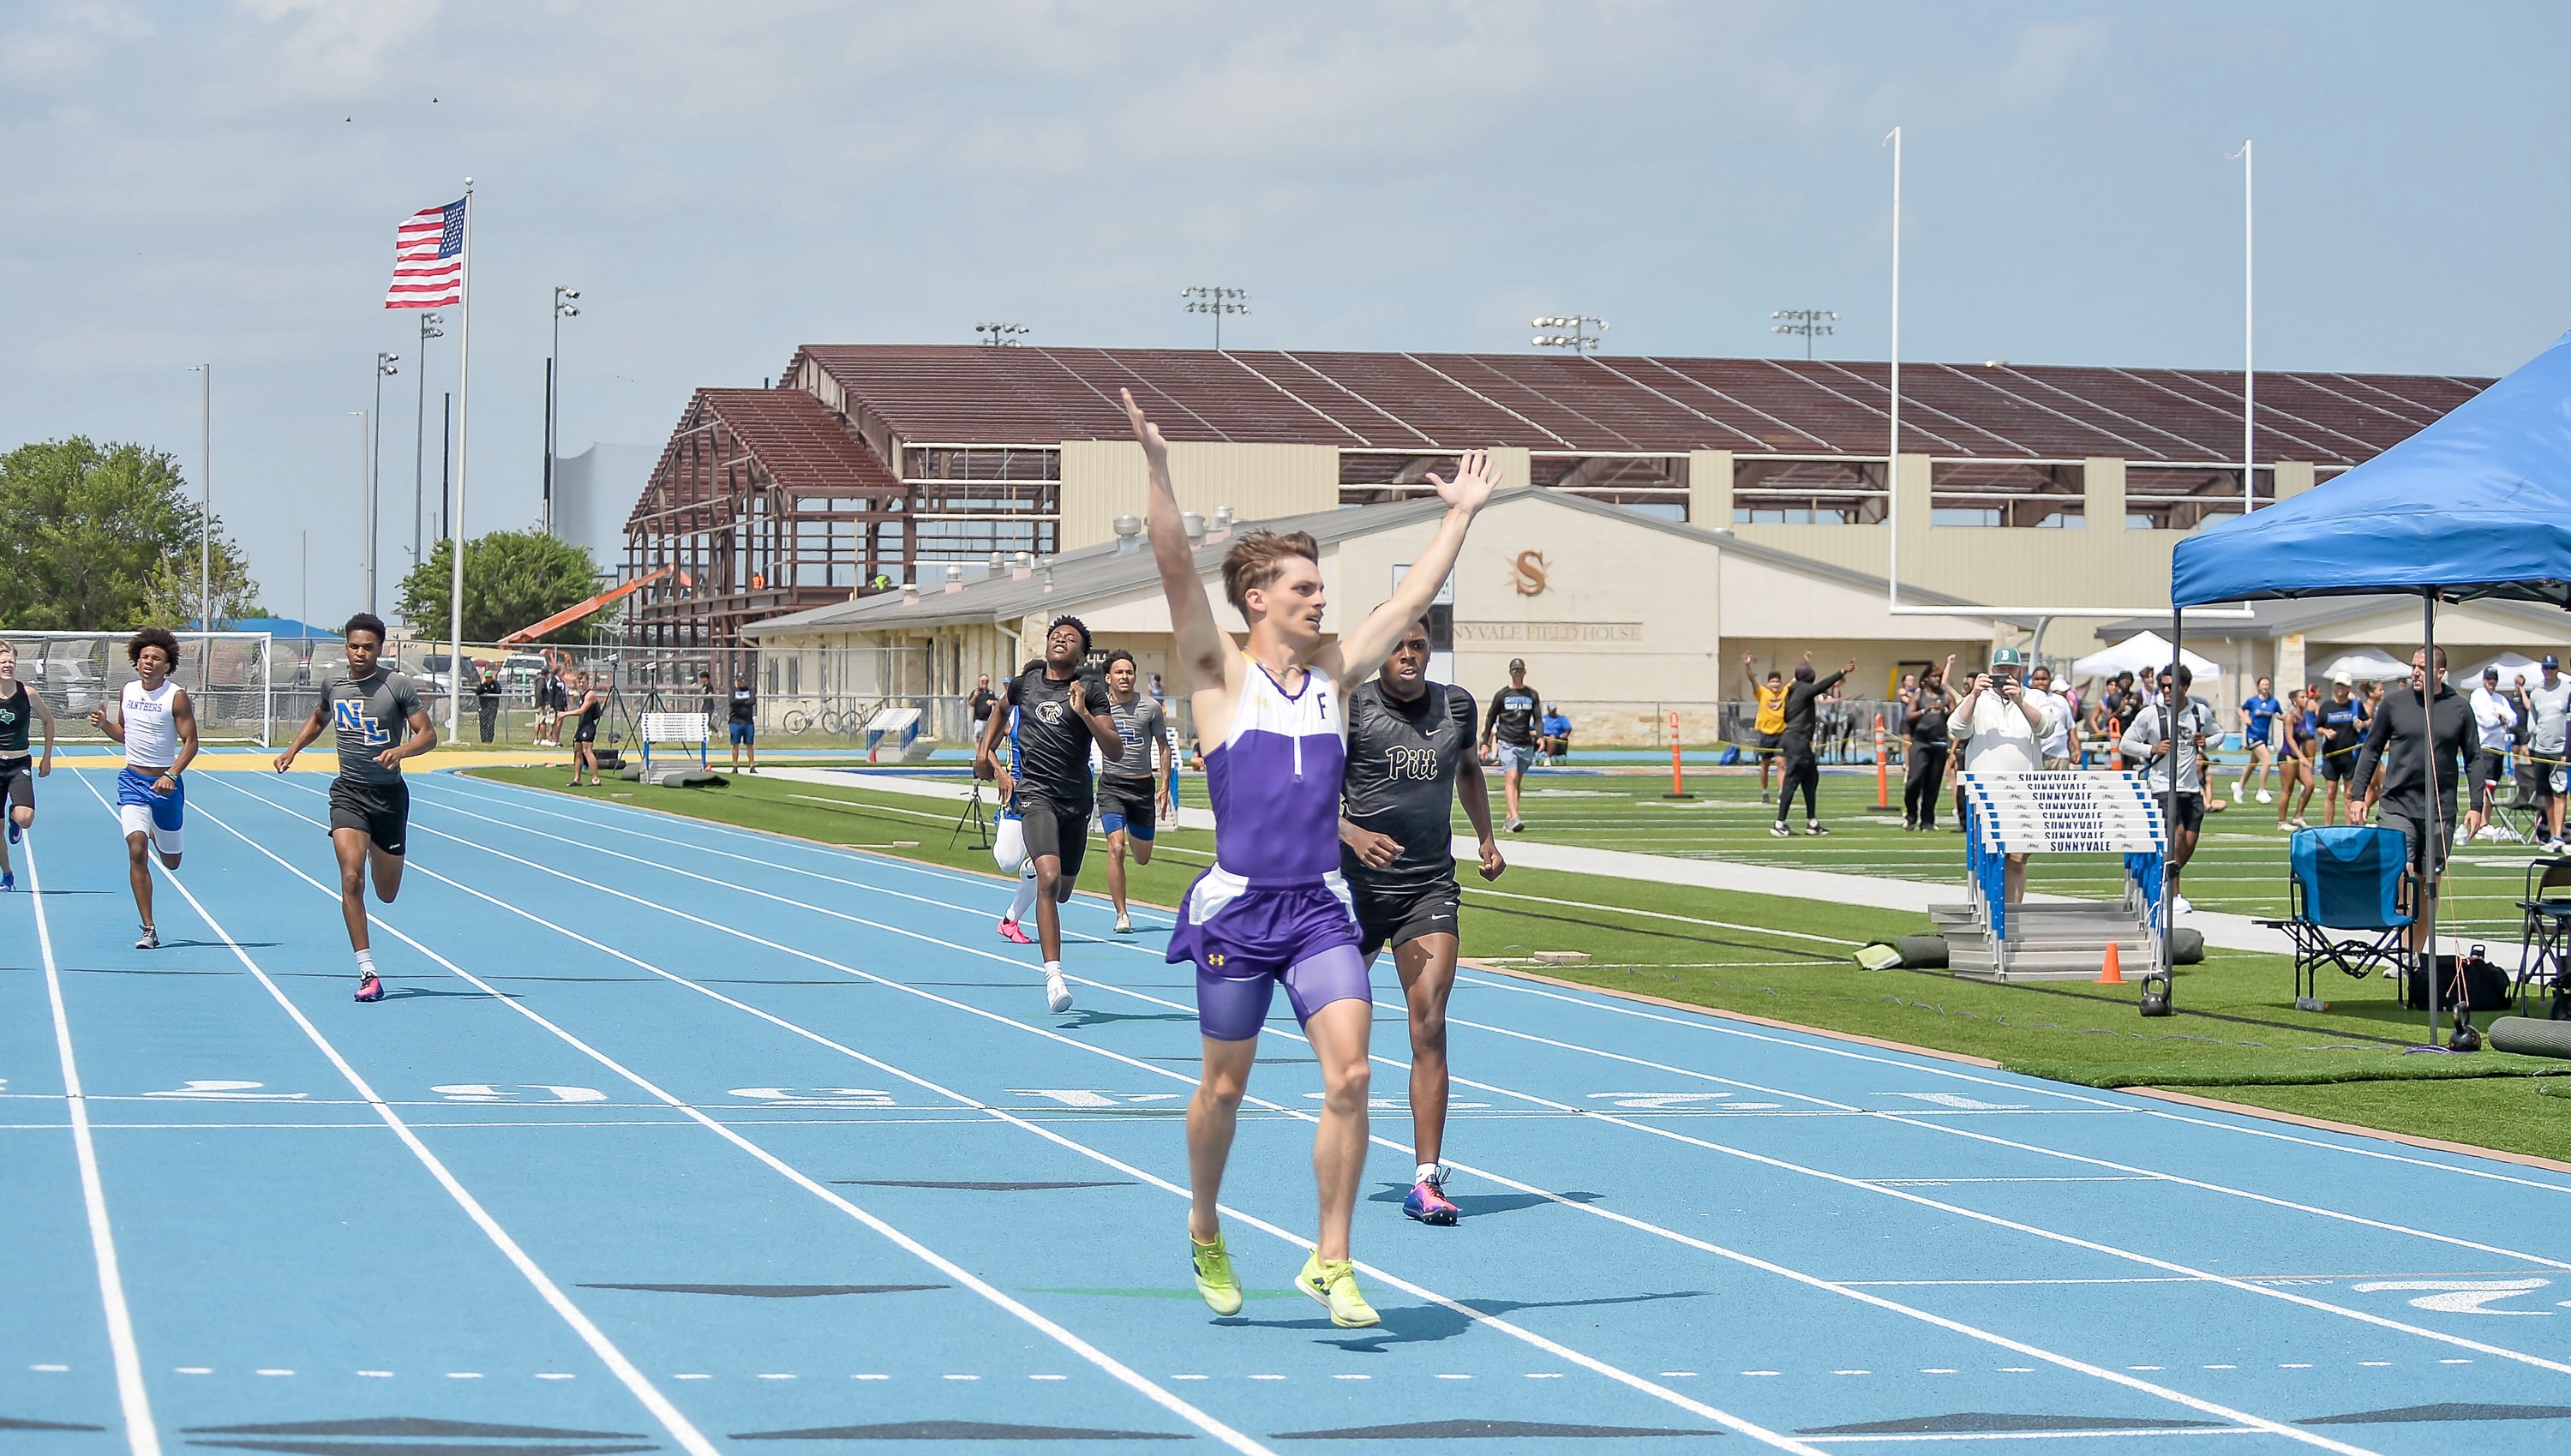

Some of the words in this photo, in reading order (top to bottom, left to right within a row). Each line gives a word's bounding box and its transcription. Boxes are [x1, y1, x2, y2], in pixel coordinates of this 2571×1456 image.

[1516, 548, 1546, 597] S
[1526, 626, 1578, 641] FIELD
[1583, 626, 1641, 641] HOUSE
[2001, 649, 2010, 661] B
[126, 699, 163, 712] PANTHERS
[1317, 692, 1327, 720] F
[333, 698, 391, 746] NL
[1385, 745, 1438, 781] Pitt
[2050, 841, 2111, 852] SUNNYVALE
[1585, 1091, 1785, 1111] 2
